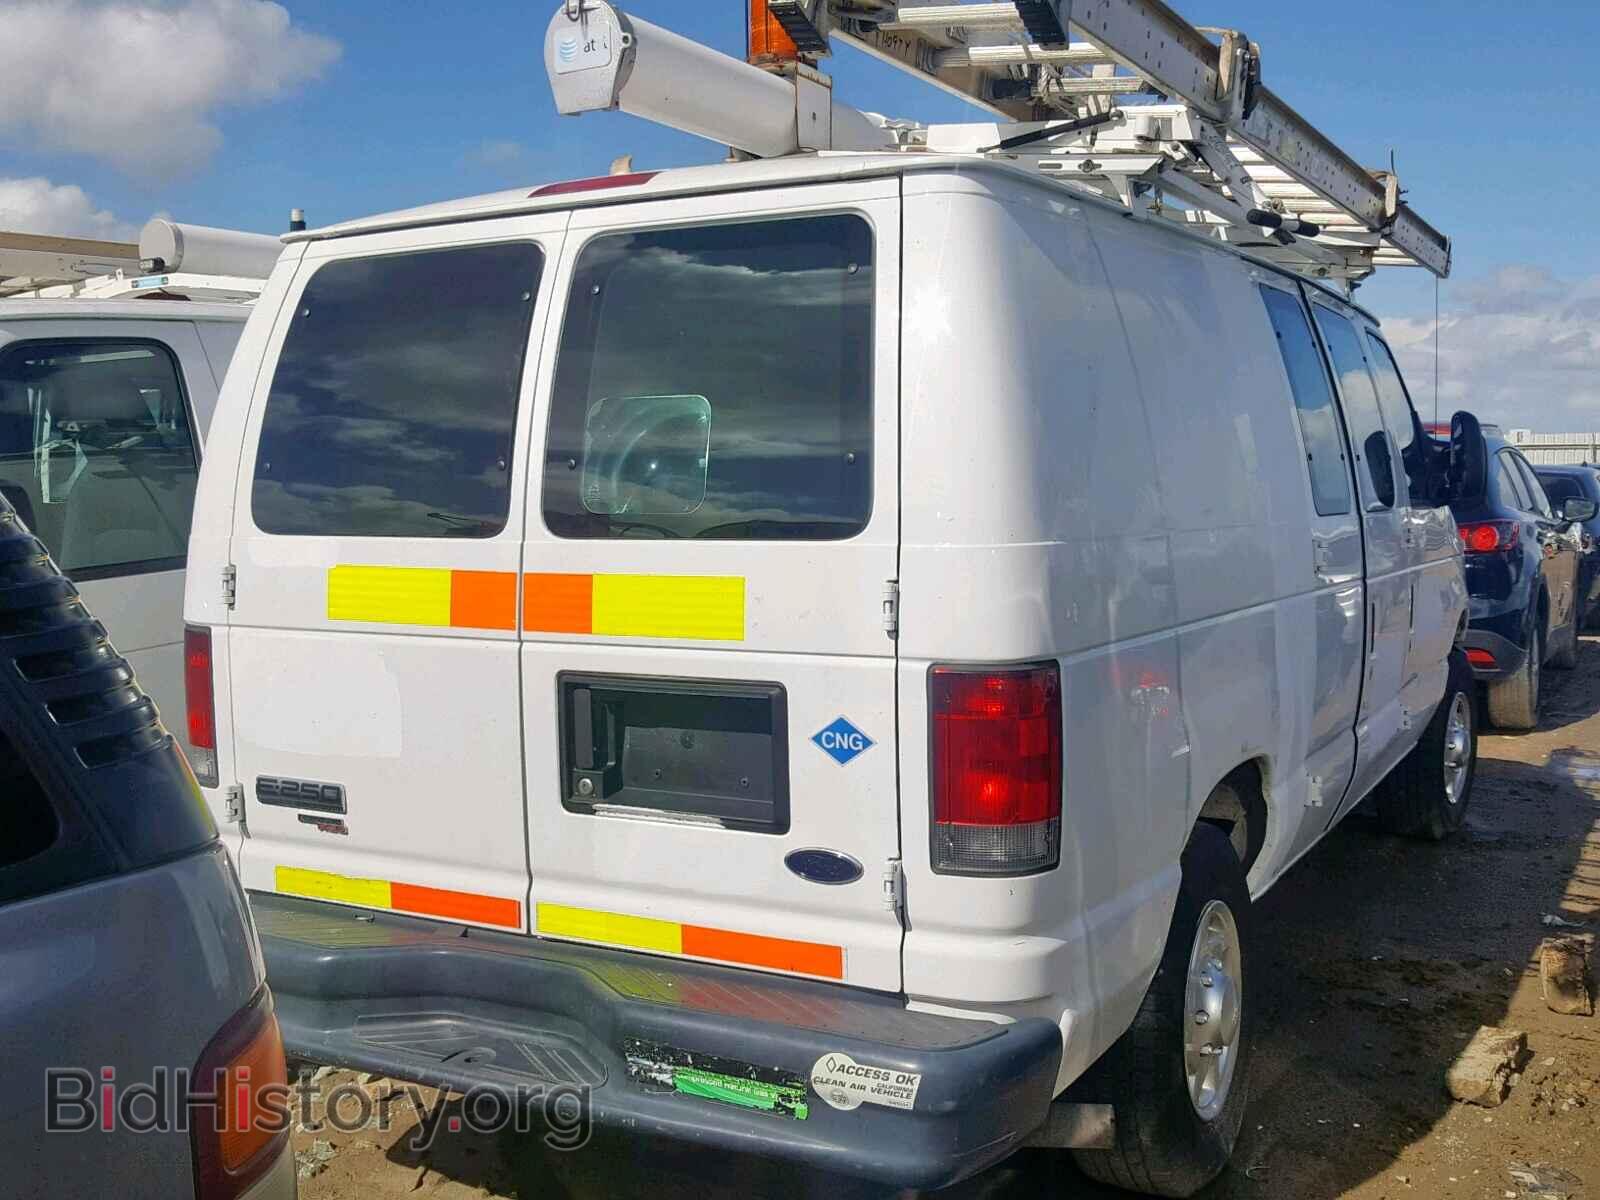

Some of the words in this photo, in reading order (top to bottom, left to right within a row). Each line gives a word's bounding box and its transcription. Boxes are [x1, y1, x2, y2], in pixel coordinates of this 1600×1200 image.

[821, 730, 864, 751] CNG
[836, 1063, 891, 1082] ACCESS
[895, 1073, 918, 1087] OK
[813, 1075, 846, 1089] CLEAN
[849, 1082, 867, 1093] AIR
[870, 1086, 913, 1101] VEHICLE
[876, 1081, 914, 1094] CALIFORNIA
